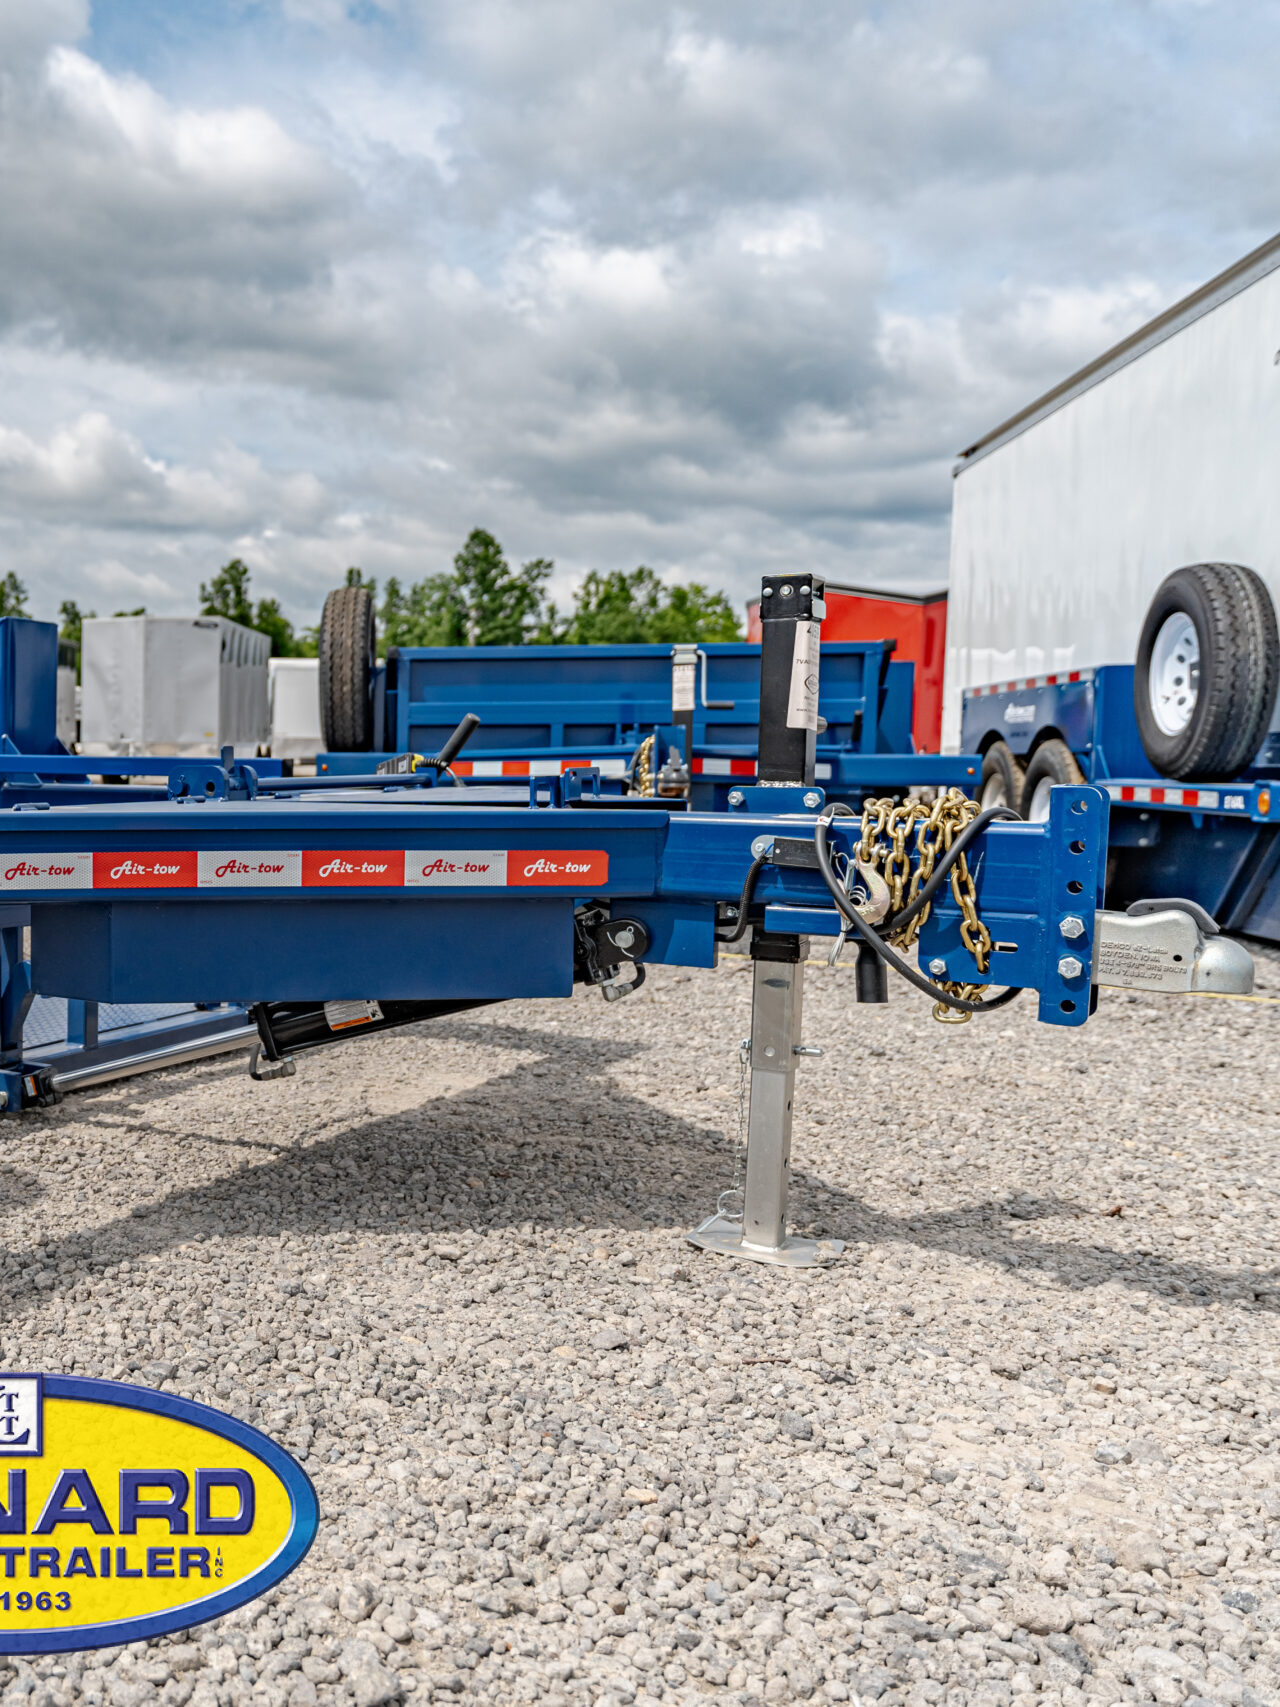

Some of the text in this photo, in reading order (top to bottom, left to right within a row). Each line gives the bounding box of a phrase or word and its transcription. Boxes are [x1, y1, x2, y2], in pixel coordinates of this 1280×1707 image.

[4, 858, 591, 880] Air-tow Air-tow Air-tow Air-tow Air-tow Air-tow
